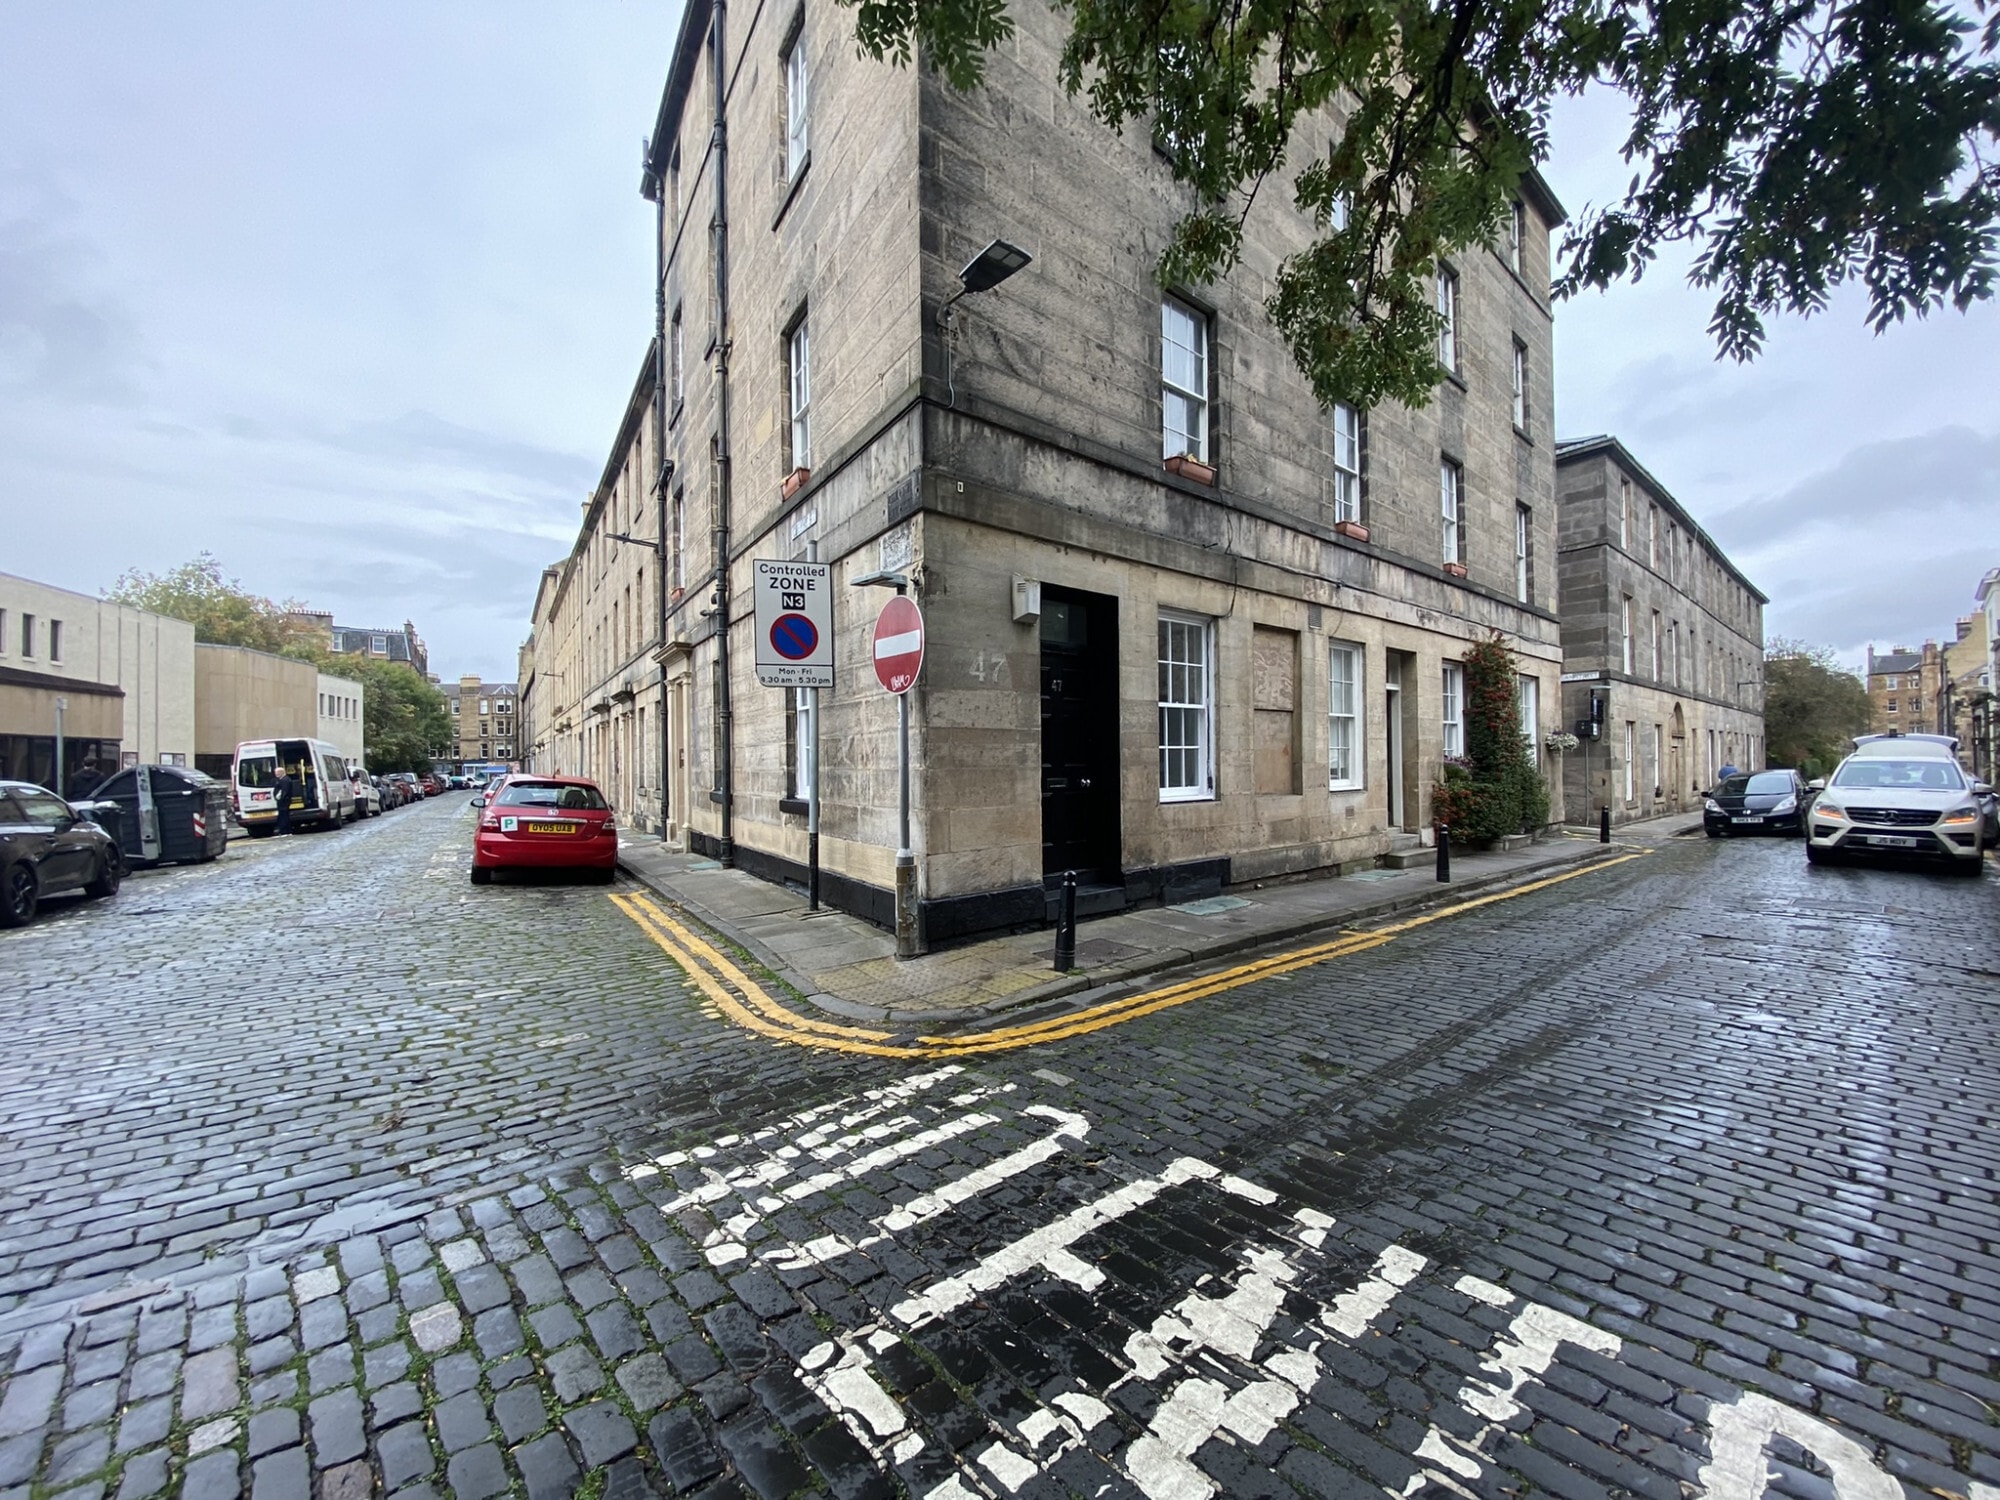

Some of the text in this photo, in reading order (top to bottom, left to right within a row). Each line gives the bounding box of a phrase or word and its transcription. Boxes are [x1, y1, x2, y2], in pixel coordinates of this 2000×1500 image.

[759, 563, 825, 577] Controlled
[769, 576, 816, 591] ZONE
[783, 595, 804, 607] N3
[969, 651, 1007, 682] 47
[1051, 679, 1063, 692] 47
